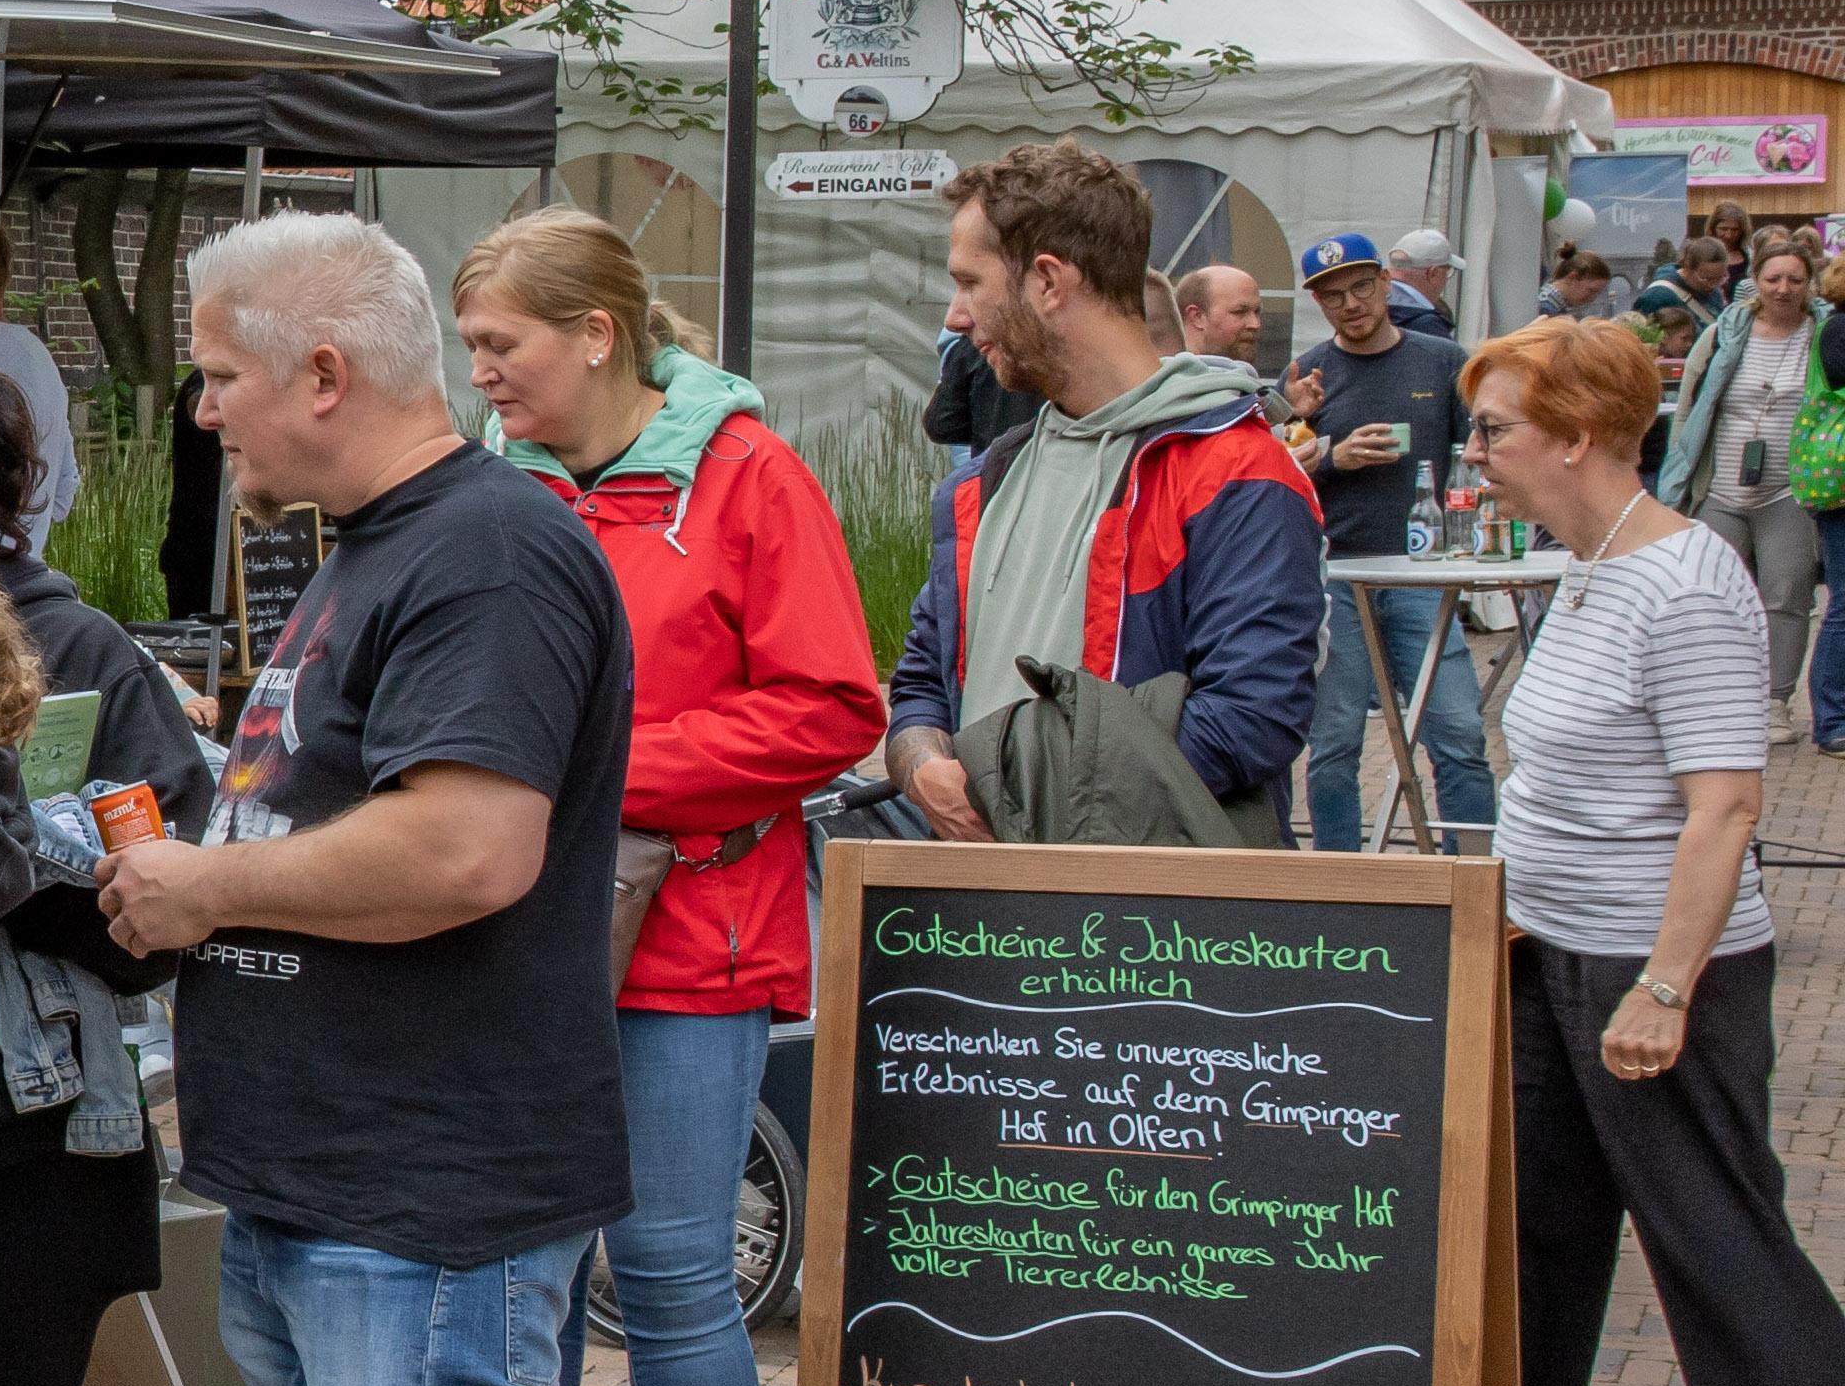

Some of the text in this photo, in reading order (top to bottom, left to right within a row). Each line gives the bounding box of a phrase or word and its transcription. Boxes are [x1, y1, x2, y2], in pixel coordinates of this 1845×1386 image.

[849, 114, 868, 130] 66
[783, 158, 879, 174] Restaurant
[1689, 144, 1733, 167] Café
[817, 177, 907, 193] EINGANG
[876, 908, 1399, 974] Gutscheine & Jahreskarten
[1019, 967, 1192, 1000] erhältlich
[876, 1023, 1328, 1084] Verschenken Sie unvergessliche
[877, 1061, 1401, 1147] Erlebnisse auf dem Grimpinger
[1001, 1110, 1047, 1143] Hof
[1065, 1116, 1097, 1146] in
[891, 1154, 1400, 1241] Gutscheine für den Grimpinger Hof
[888, 1208, 1384, 1280] Jahreskarten für ein ganzes Jahr
[890, 1249, 1248, 1301] voller Tiererlebnisse
